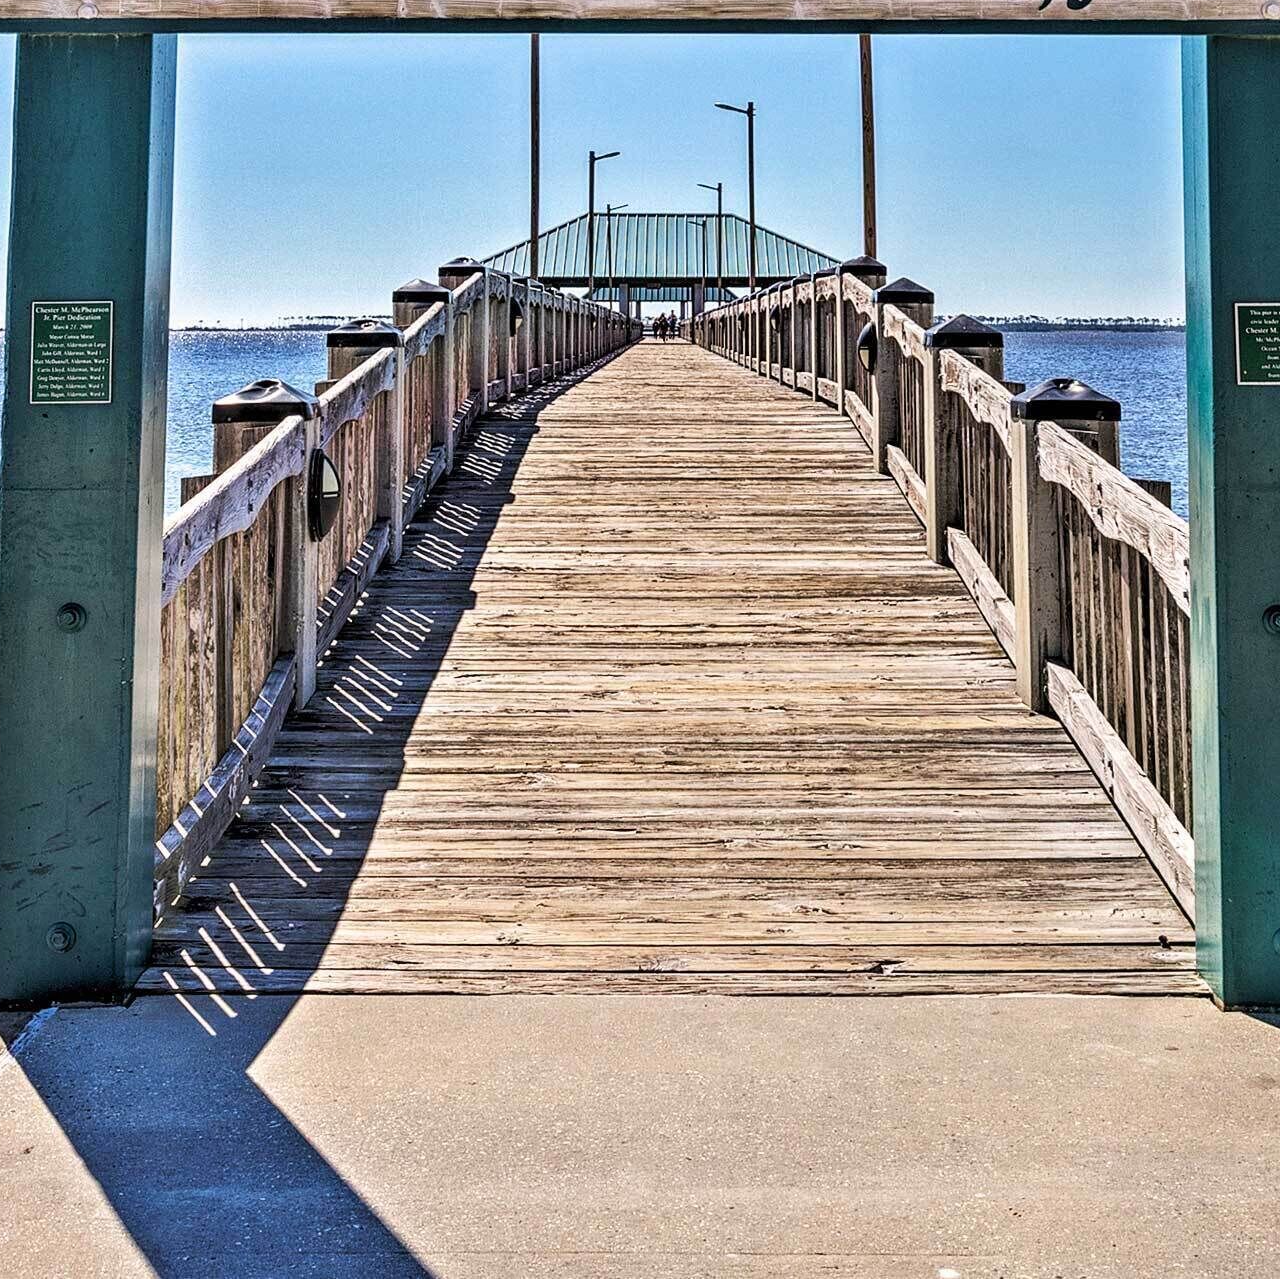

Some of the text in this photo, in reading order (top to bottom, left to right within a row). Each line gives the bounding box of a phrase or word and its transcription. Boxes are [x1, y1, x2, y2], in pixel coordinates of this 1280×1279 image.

[35, 306, 109, 314] Chester M. McPhearson
[43, 313, 101, 321] Jr. Pier Dedication
